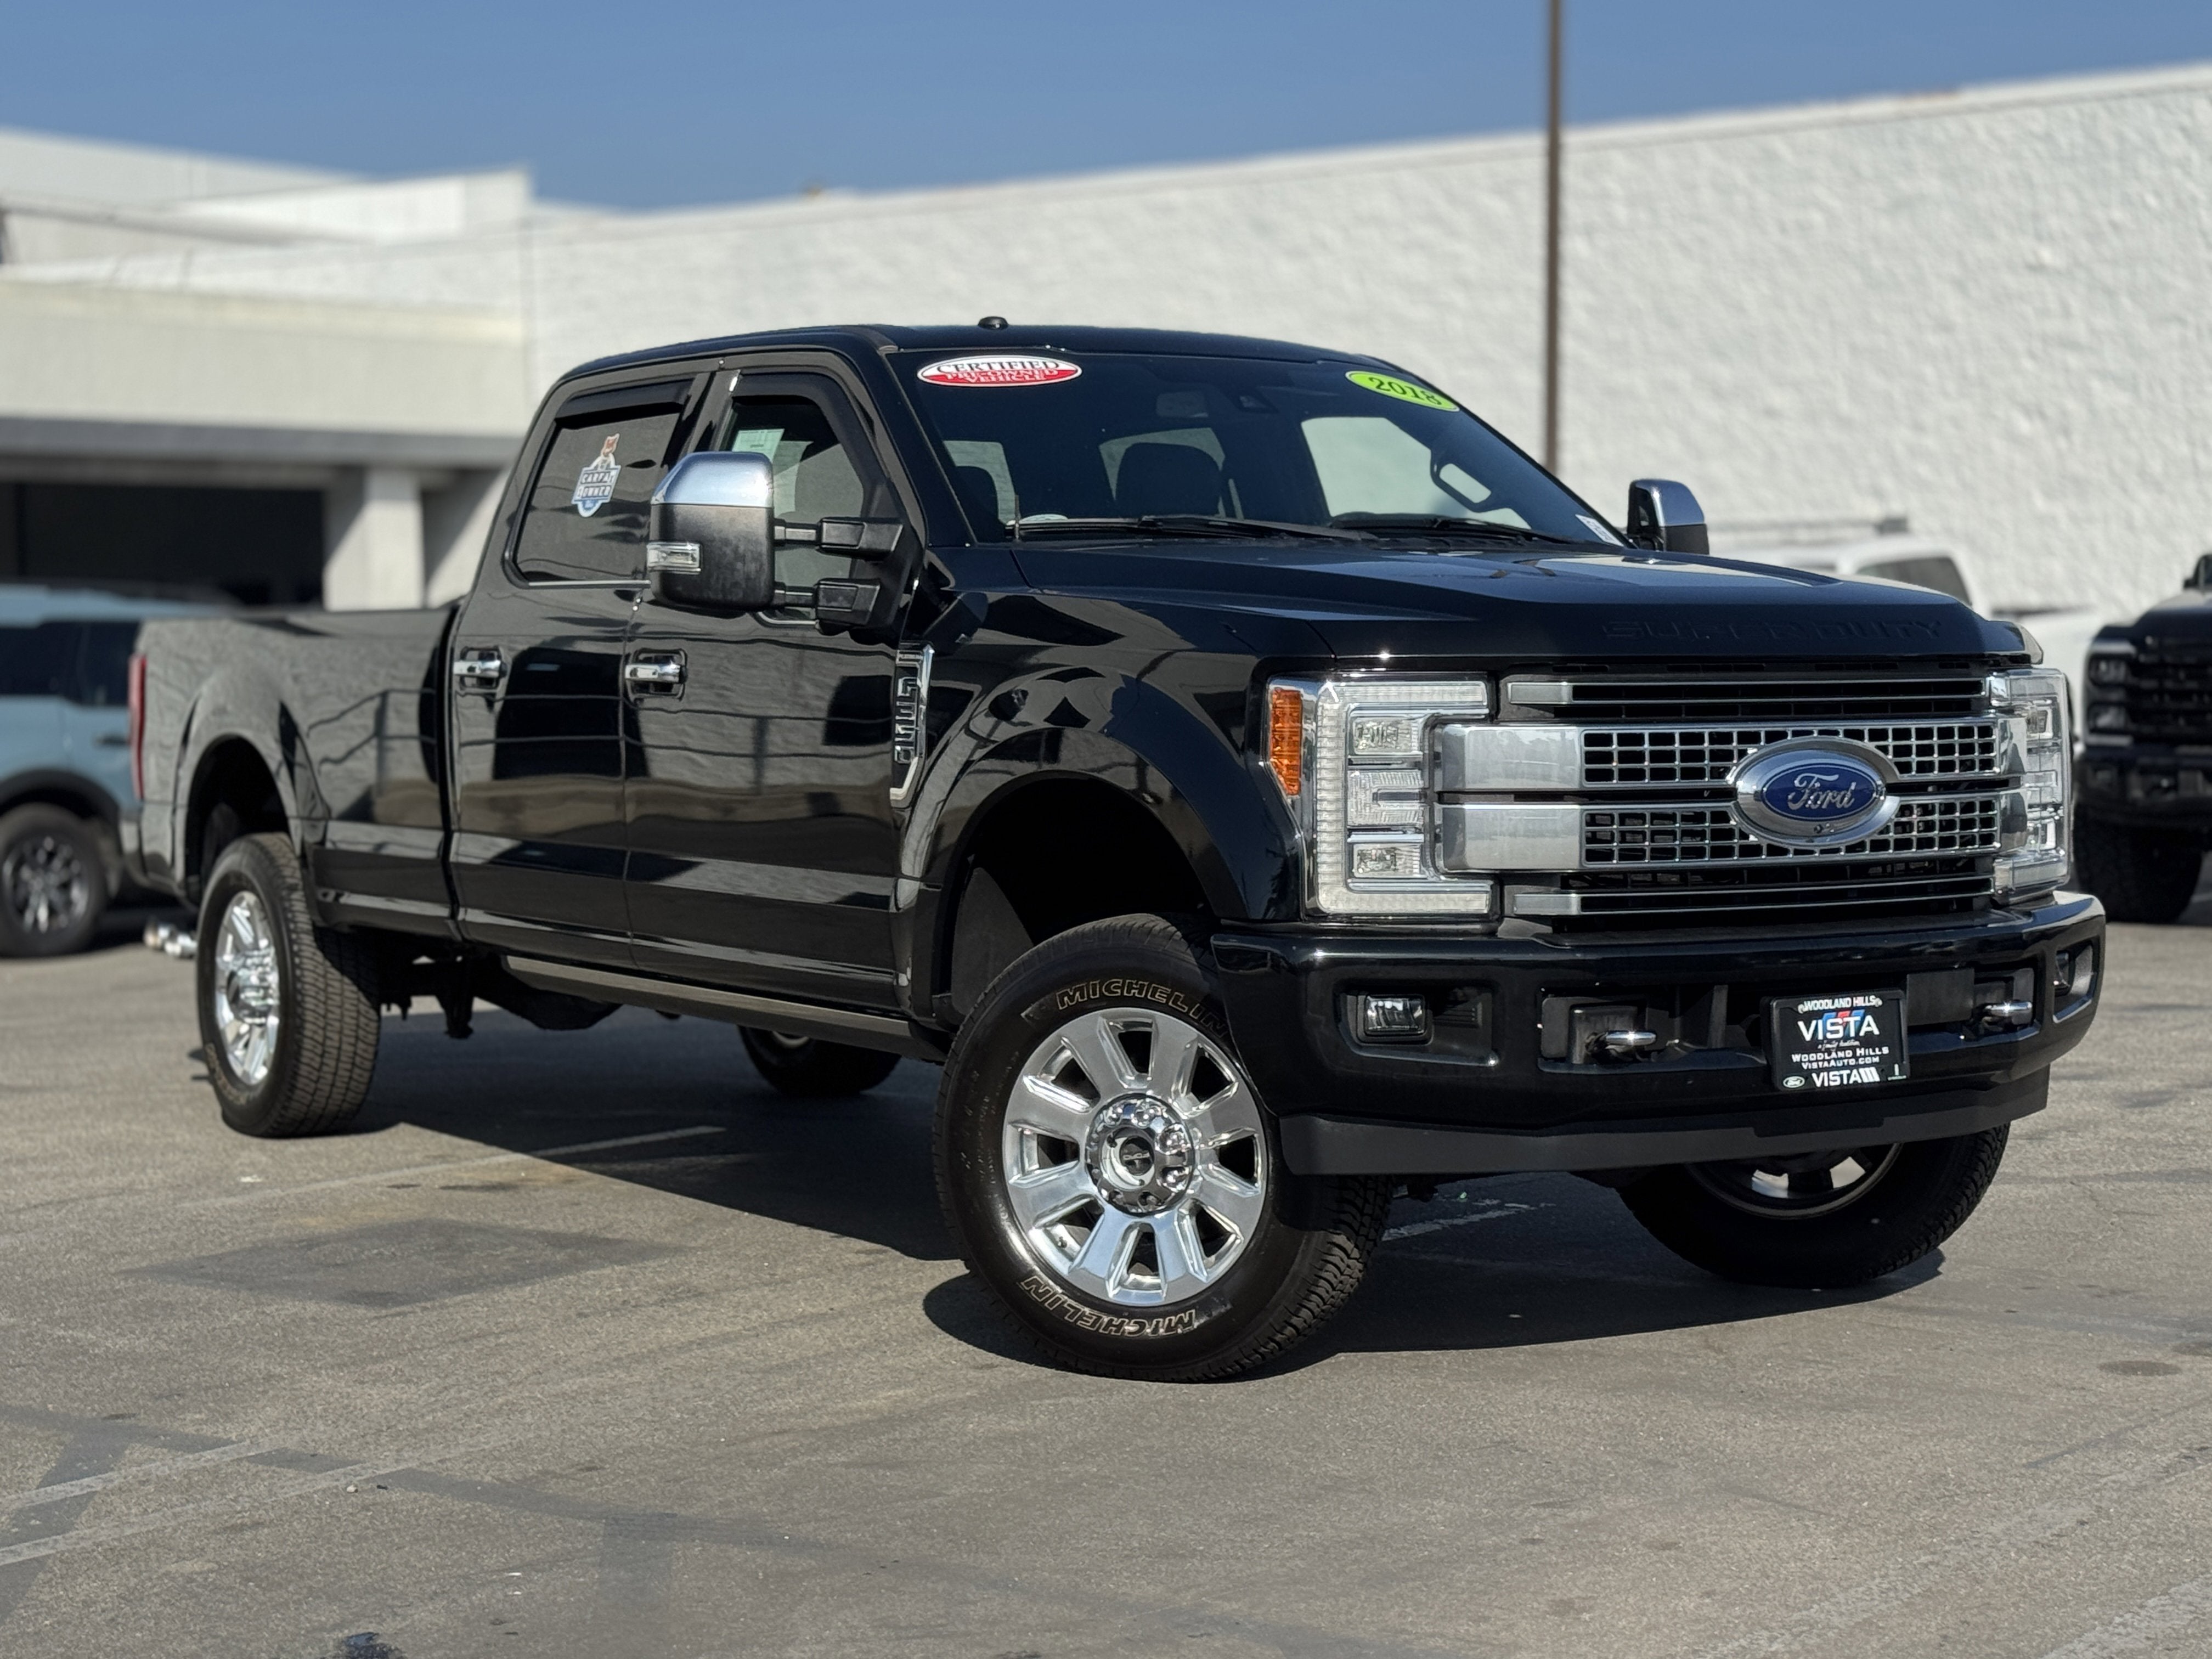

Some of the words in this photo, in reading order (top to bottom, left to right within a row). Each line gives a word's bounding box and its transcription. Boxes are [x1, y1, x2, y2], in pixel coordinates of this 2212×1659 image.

[937, 360, 1059, 373] CERTIFIED
[1369, 377, 1442, 405] 2018
[1814, 620, 1941, 640] DUTY
[1787, 773, 1856, 810] Ford
[1057, 979, 1229, 1038] MICHELIN
[1804, 997, 1852, 1011] WOODLAND
[1853, 995, 1876, 1007] HILLS
[1797, 1015, 1880, 1041] VISTA
[1022, 1276, 1195, 1336] MICHELIN
